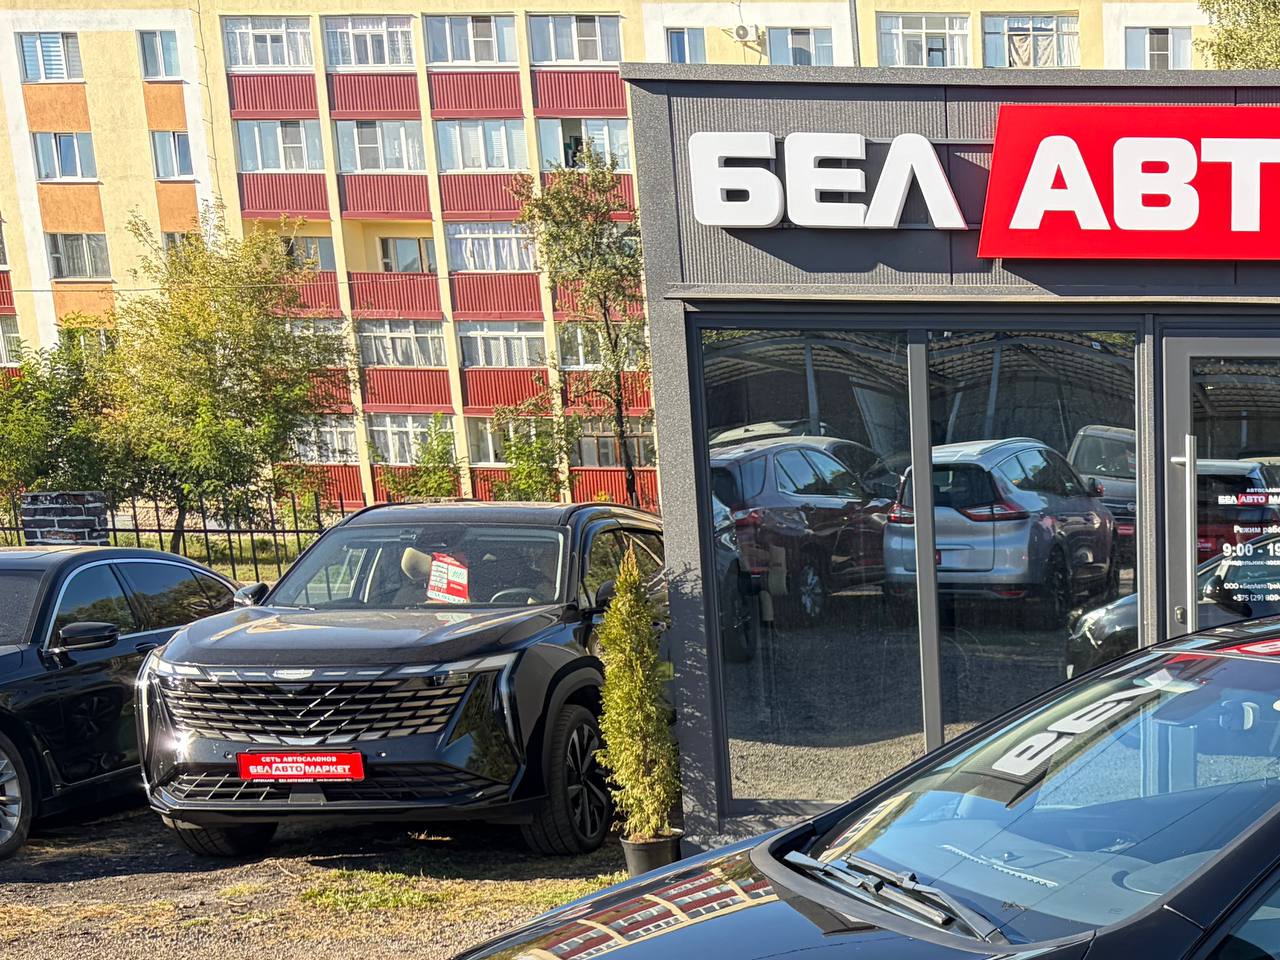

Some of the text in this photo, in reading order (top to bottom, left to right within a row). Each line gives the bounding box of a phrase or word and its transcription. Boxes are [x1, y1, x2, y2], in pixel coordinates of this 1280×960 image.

[688, 131, 969, 231] БЕЛ
[1218, 495, 1237, 504] БЕЛ
[1240, 495, 1266, 504] АВТО
[1233, 525, 1261, 534] Режим
[1222, 543, 1254, 557] 9:00
[1250, 593, 1265, 601] (29)
[249, 765, 351, 774] БЕЛ АВТО МАРКЕТ
